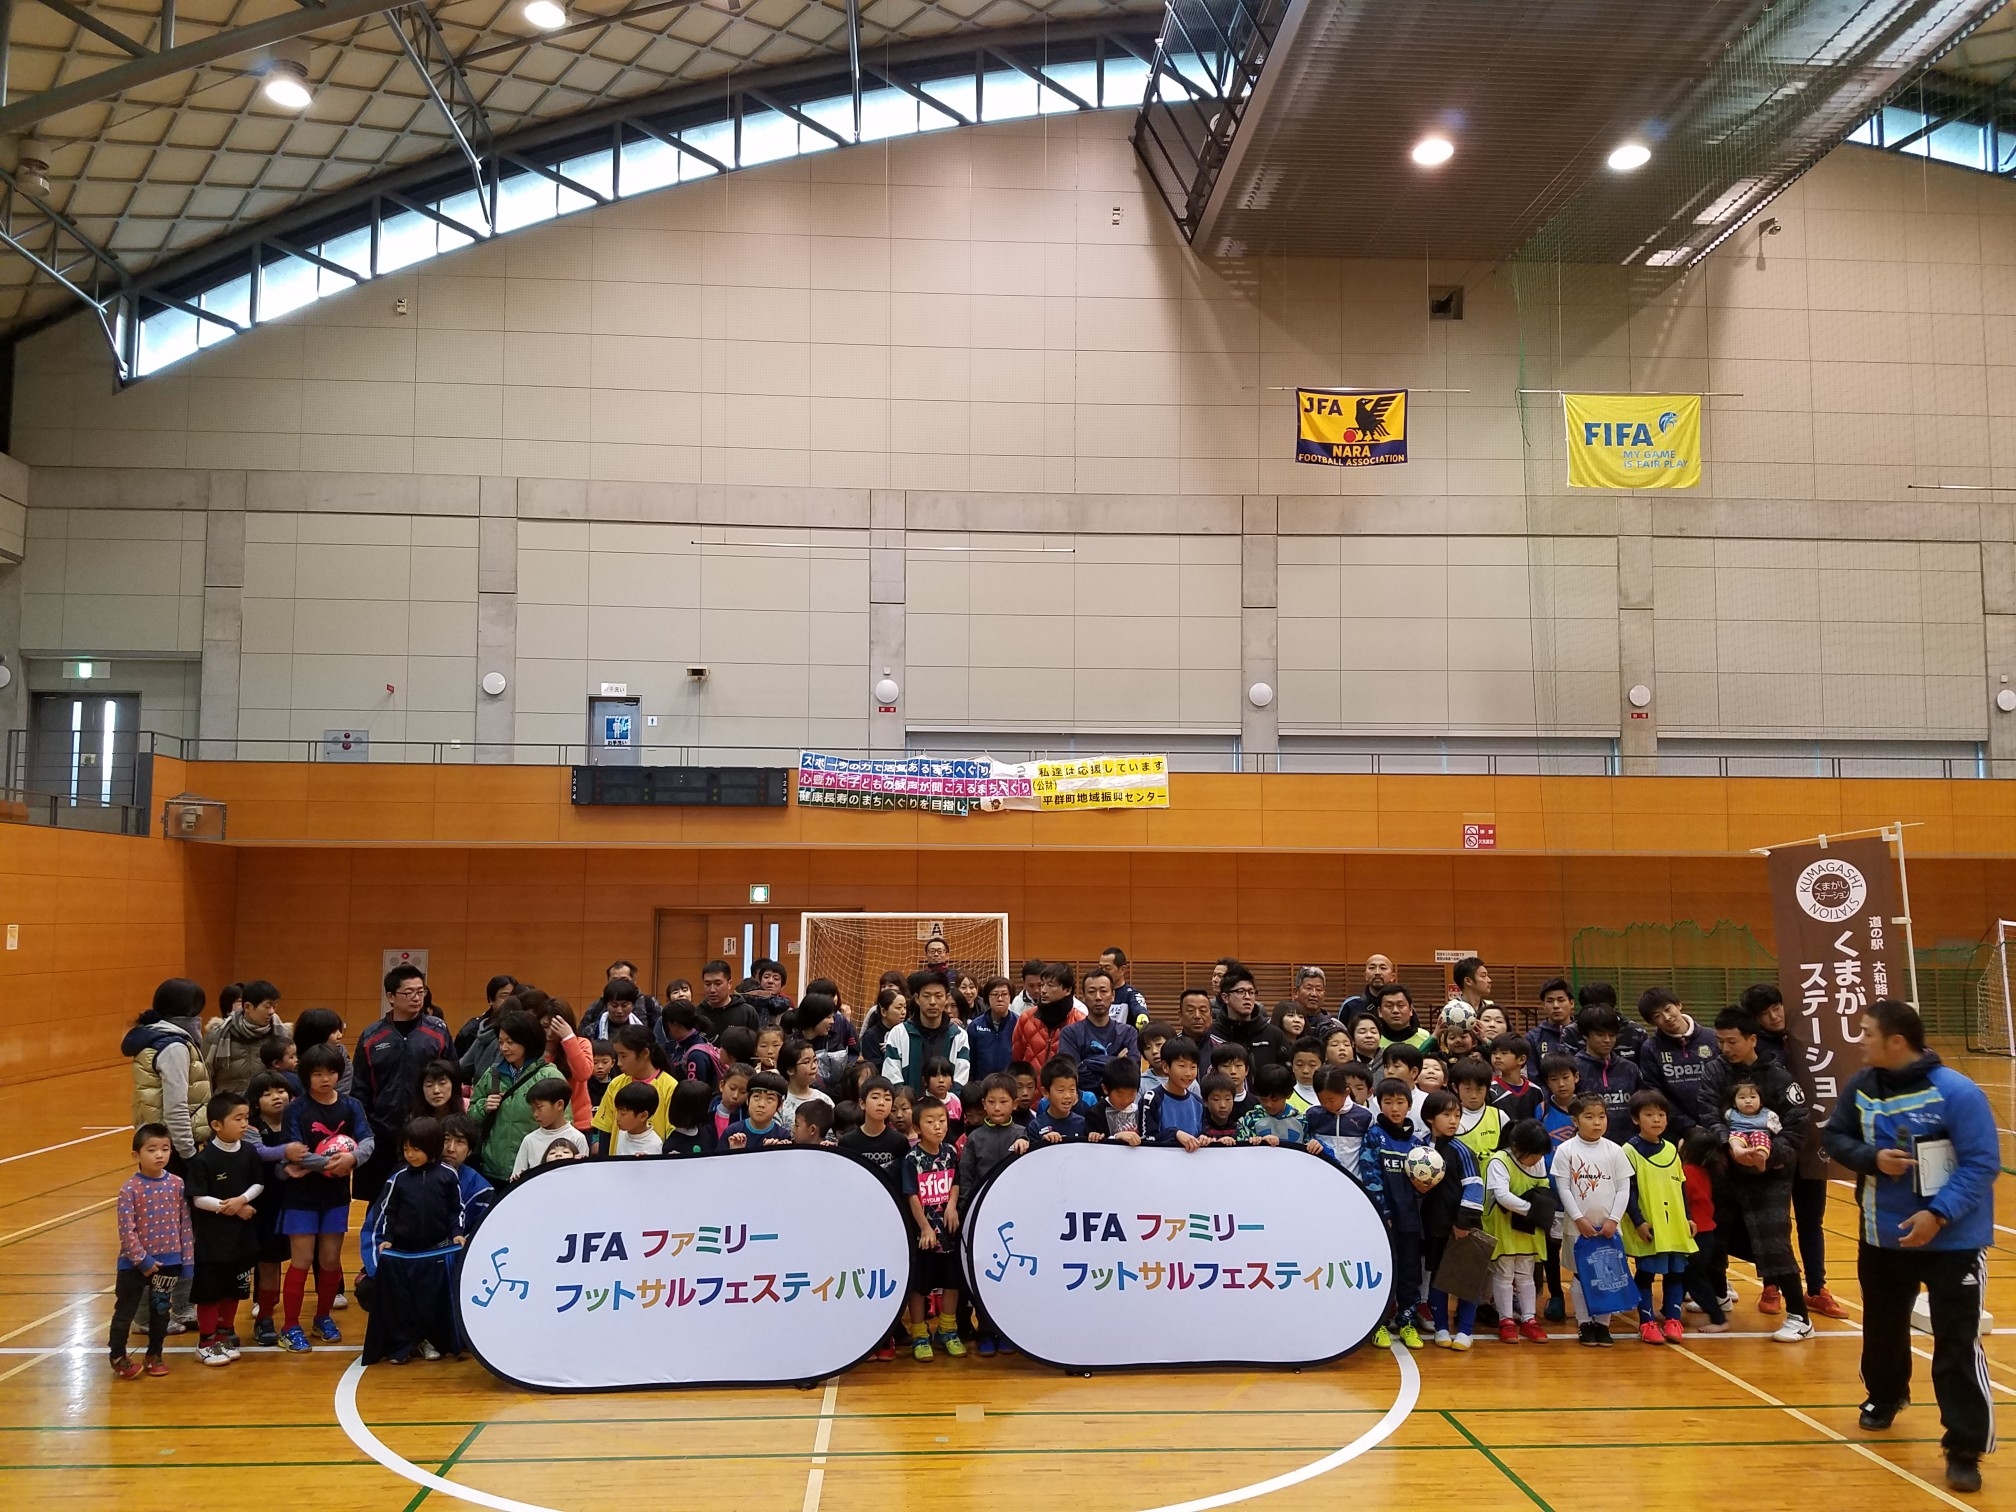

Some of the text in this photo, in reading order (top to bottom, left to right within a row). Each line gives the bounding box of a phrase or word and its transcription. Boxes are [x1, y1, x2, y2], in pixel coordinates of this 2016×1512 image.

[1304, 397, 1343, 416] JFA
[1584, 422, 1654, 447] FIFA
[1299, 453, 1405, 466] FOOTBALL ASSOCIATION
[1332, 445, 1372, 457] NARA
[1623, 450, 1676, 459] MY GAME
[1623, 460, 1689, 469] IS FAIR PLAY
[1038, 760, 1163, 777] 私達は応援しています
[1043, 791, 1166, 806] 平群町地域振興センター
[1800, 862, 1863, 893] KUMAGASHI
[1814, 880, 1849, 891] くまがし
[1815, 890, 1850, 901] ステーション
[1809, 897, 1860, 919] STATION
[932, 923, 942, 936] A
[1869, 916, 1884, 950] 道の駅
[1834, 930, 1867, 1043] くまがし
[1541, 1041, 1548, 1052] 6
[1800, 963, 1838, 1129] ステーション
[1661, 1051, 1673, 1063] 16
[1662, 1061, 1705, 1079] Spazi
[1060, 1211, 1265, 1242] JFA ファミリー
[556, 1224, 779, 1263] JFA ファミリー
[1062, 1261, 1383, 1291] フットサルフェスティバル
[556, 1268, 897, 1313] フットサルフェスティバル
